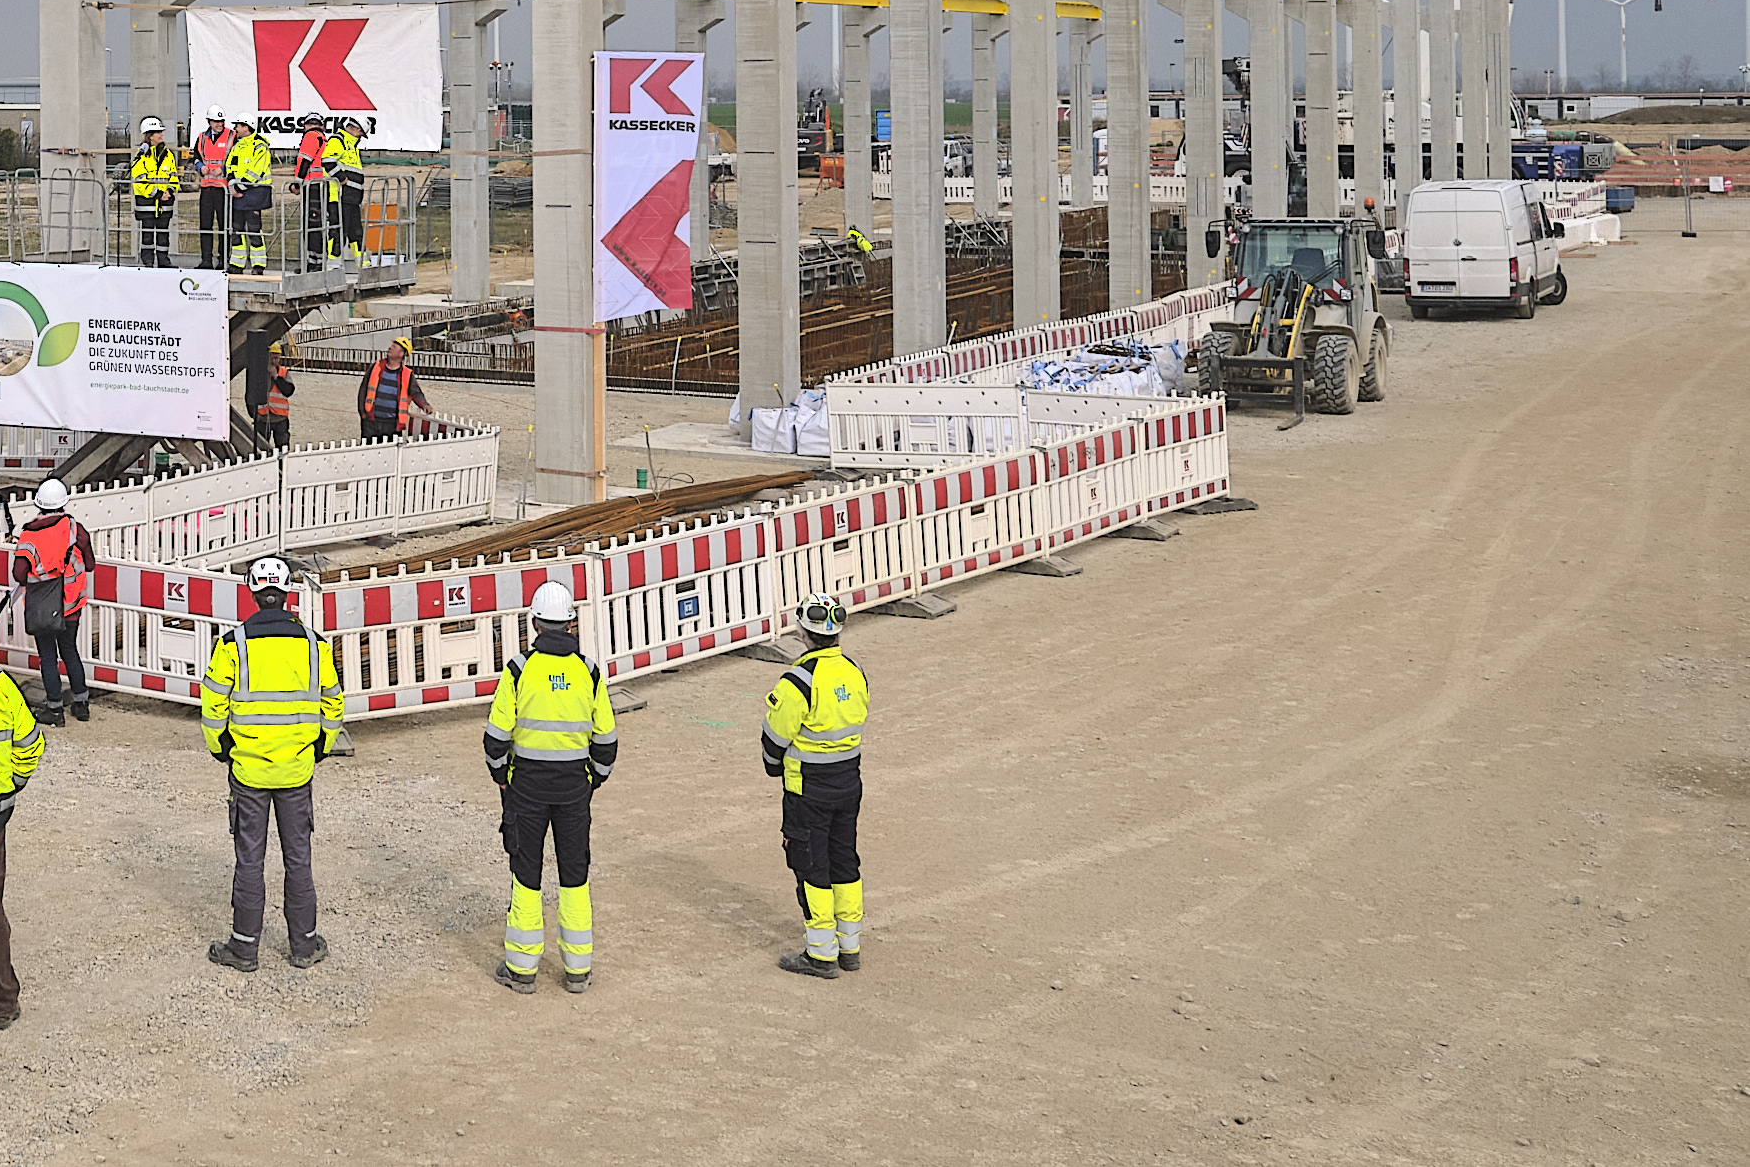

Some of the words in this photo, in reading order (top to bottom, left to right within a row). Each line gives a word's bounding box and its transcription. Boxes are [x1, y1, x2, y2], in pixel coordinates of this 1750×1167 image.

[609, 119, 696, 133] KASSECKER
[88, 318, 161, 332] ENERGIEPARK
[88, 333, 110, 343] BAD
[112, 334, 182, 347] LAUCHSTÄDT
[89, 347, 106, 357] DIE
[108, 347, 156, 360] ZUKUNFT
[158, 351, 179, 362] DES
[88, 360, 132, 373] GRÜNEN
[134, 363, 215, 378] WASSERSTOFFS
[90, 381, 190, 395] energiepark-bad-lauchstaedt.de
